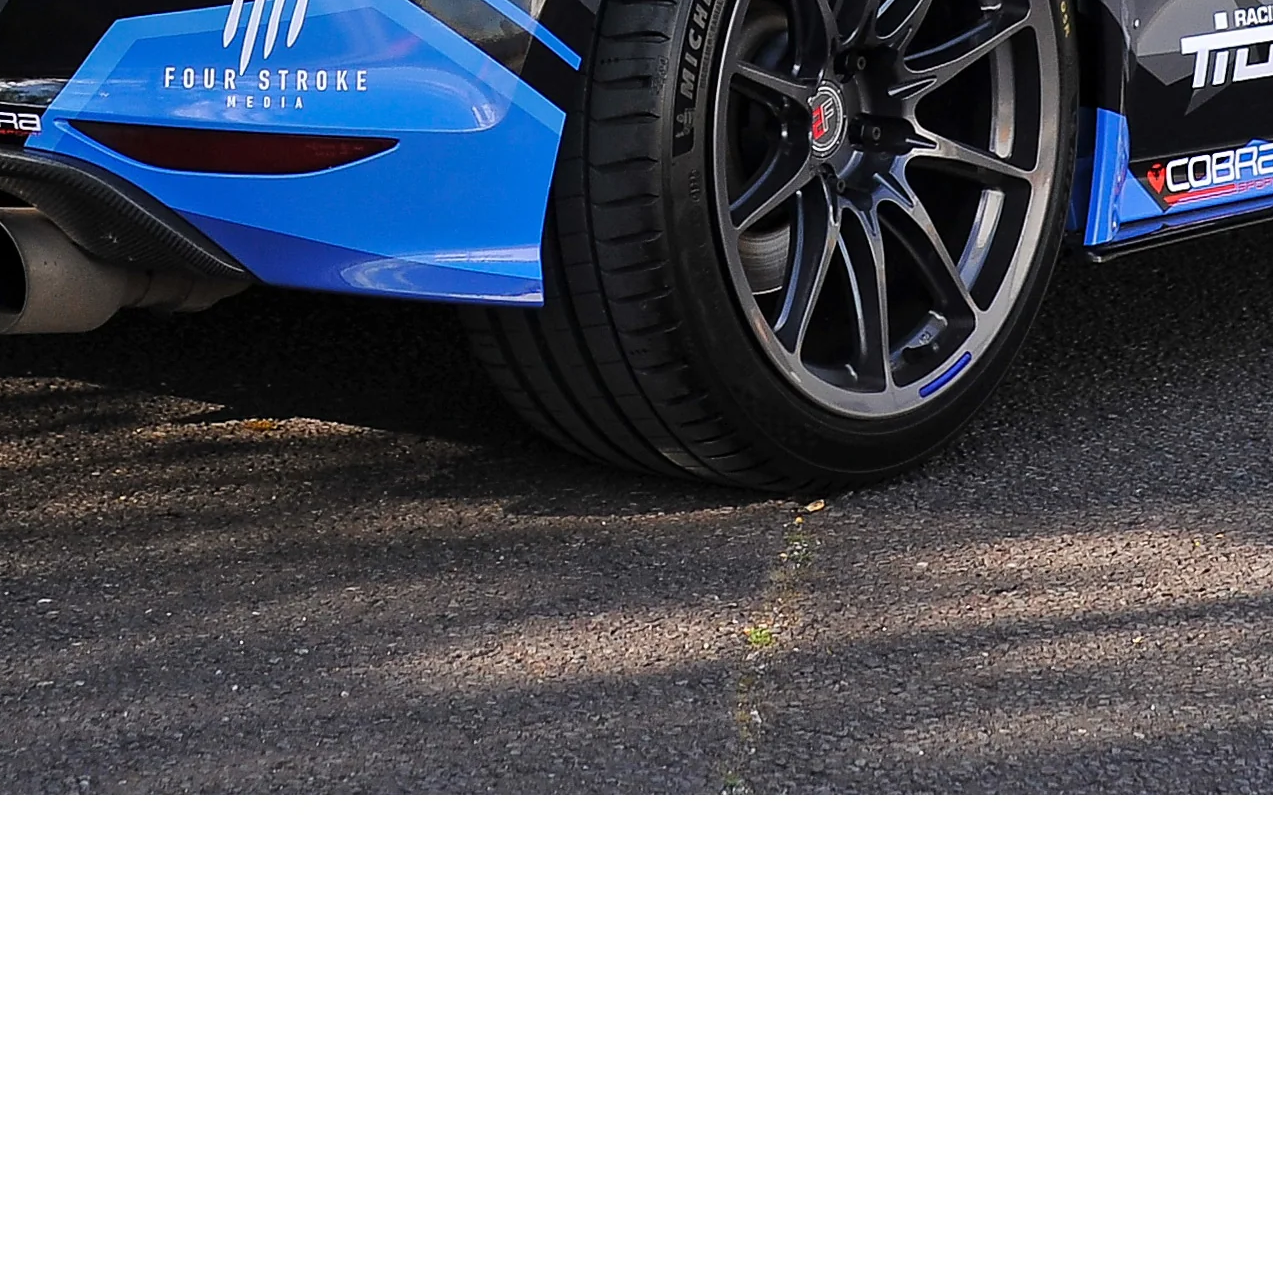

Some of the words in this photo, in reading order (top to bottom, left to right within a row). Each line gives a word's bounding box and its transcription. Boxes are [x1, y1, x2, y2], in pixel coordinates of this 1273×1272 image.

[164, 66, 237, 91] FOUR
[259, 68, 368, 92] STROKE
[227, 95, 304, 109] MEDIA
